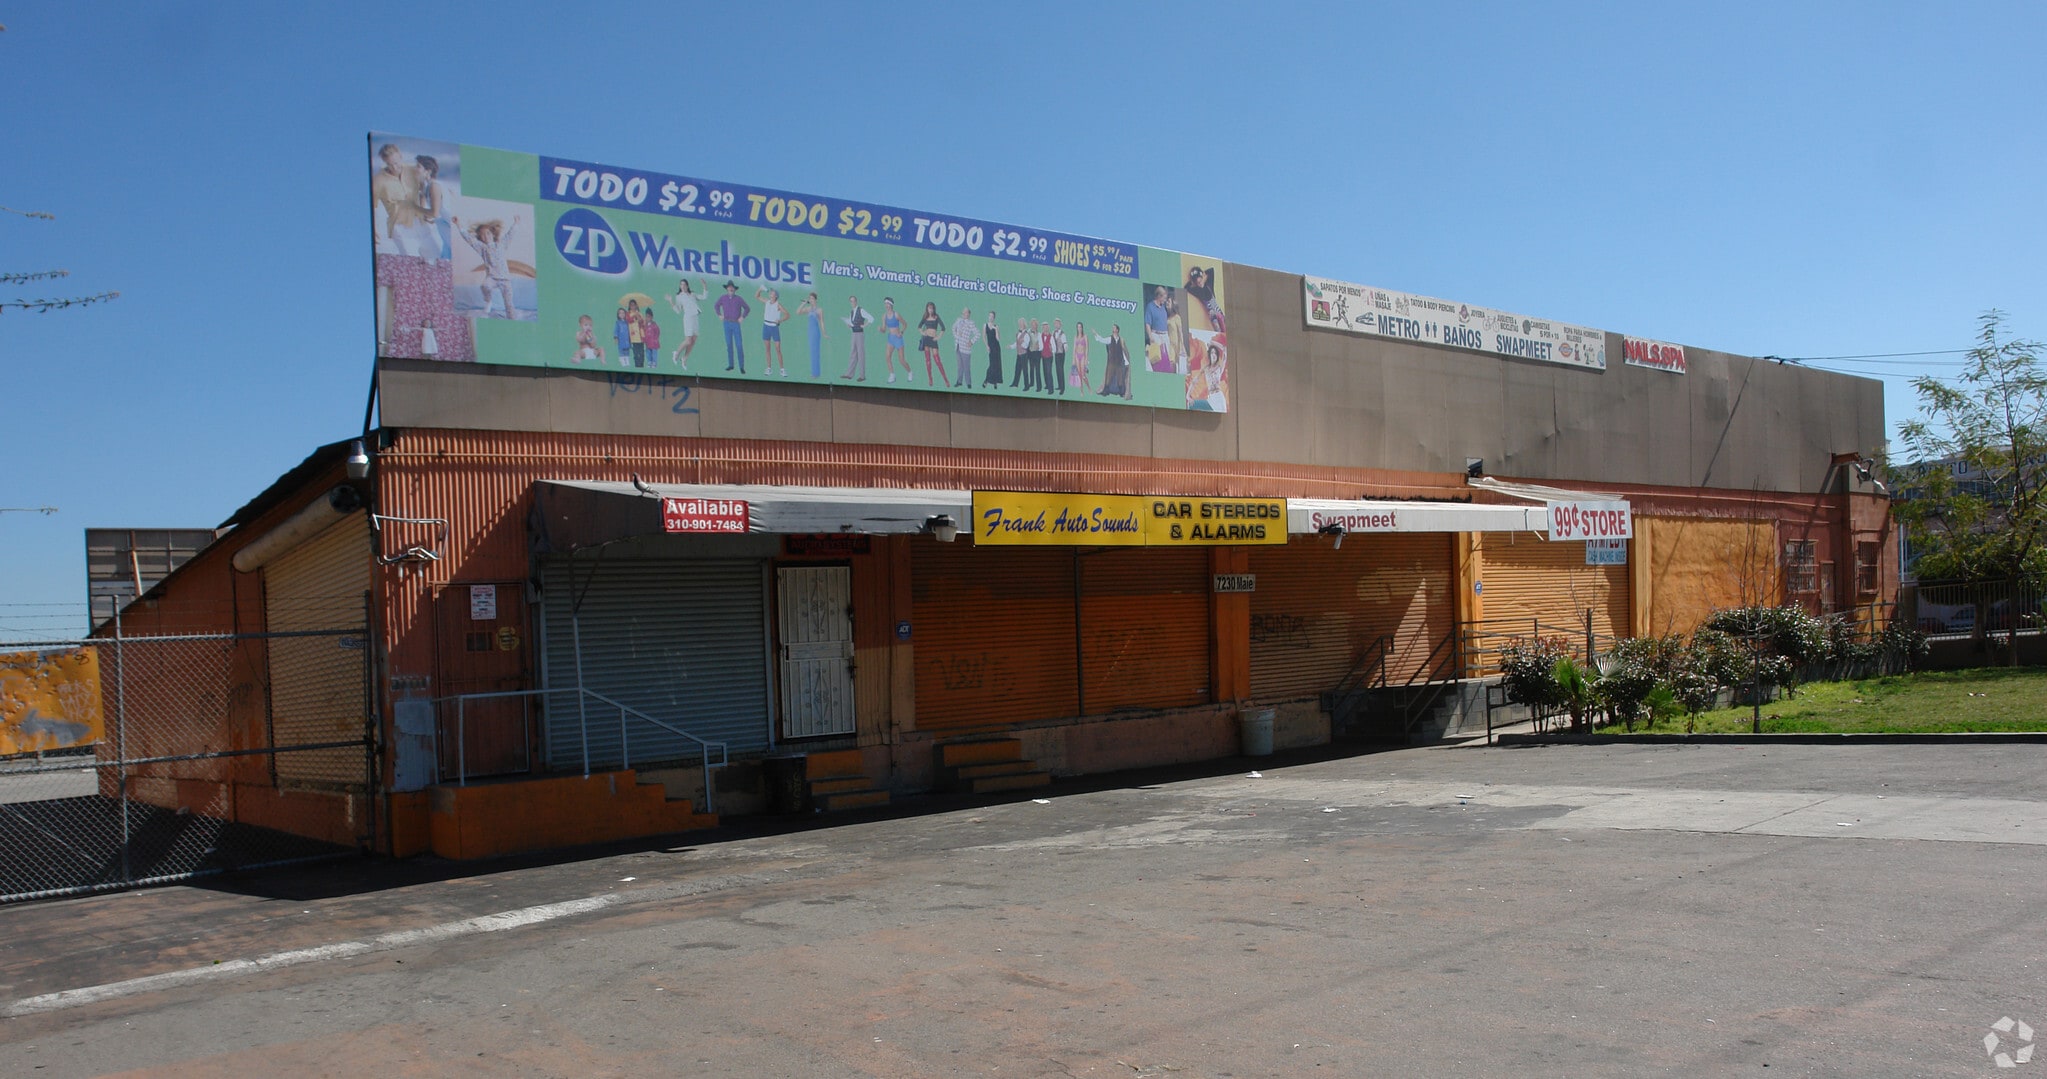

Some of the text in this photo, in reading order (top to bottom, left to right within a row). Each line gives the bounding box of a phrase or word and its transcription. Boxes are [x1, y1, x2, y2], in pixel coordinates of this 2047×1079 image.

[554, 166, 648, 206] TODO
[659, 181, 735, 214] $2.99
[748, 193, 828, 230] TODO
[837, 206, 903, 237] $2.99
[913, 217, 983, 251] TODO
[991, 229, 1048, 258] $2.99
[1054, 239, 1090, 268] SHOES
[562, 225, 616, 268] ZP
[1093, 259, 1100, 270] 4
[1113, 261, 1132, 275] $20
[822, 260, 1137, 313] Men's, Women's, Children's Clothing, Shoes & Accessory
[1377, 314, 1552, 360] METRO BAÑOS SWAPMEET
[666, 499, 743, 515] Available
[1153, 502, 1281, 520] CAR STEREOS
[984, 507, 1139, 537] Frank Auto Sounds
[1170, 523, 1266, 541] & ALARMS
[1312, 511, 1396, 532] Swapmeet
[1554, 503, 1627, 537] 99¢ STORE
[1216, 576, 1236, 590] 7230
